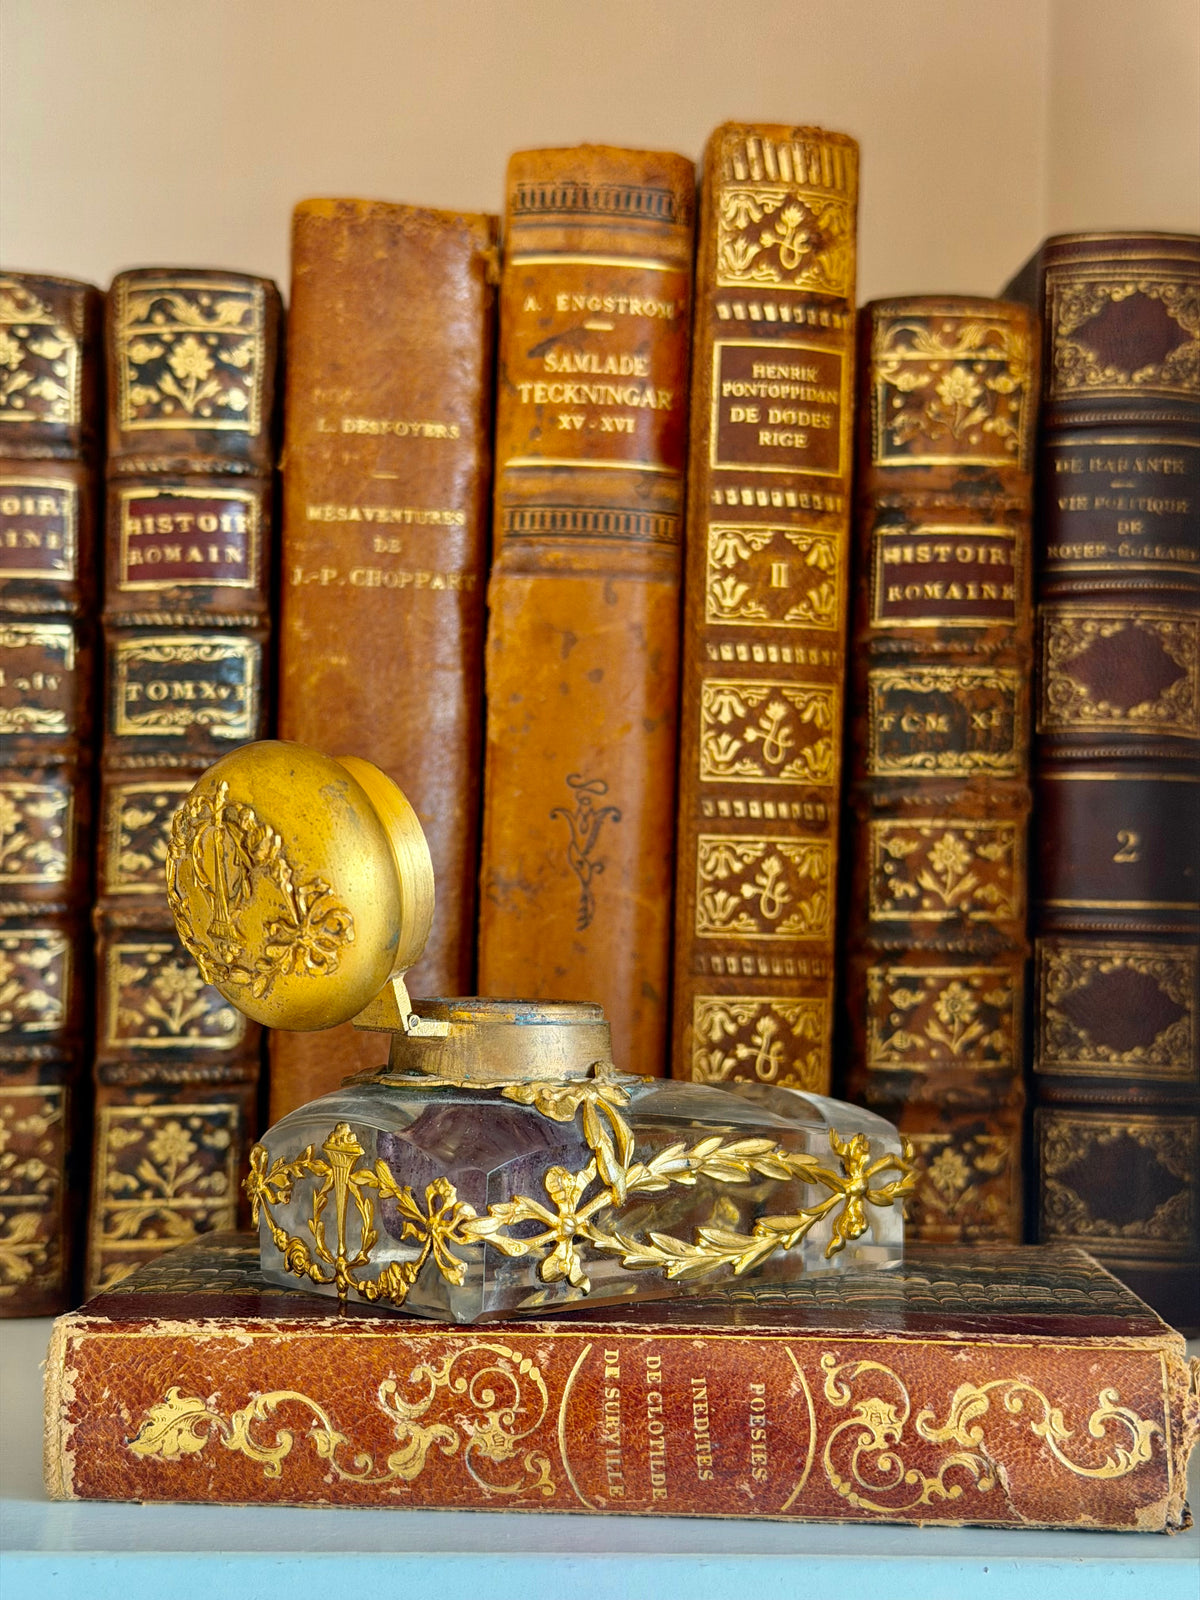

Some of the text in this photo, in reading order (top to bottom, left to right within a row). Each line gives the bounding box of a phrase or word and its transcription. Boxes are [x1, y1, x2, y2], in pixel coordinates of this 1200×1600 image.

[544, 352, 650, 377] SAMLADE
[752, 363, 818, 382] HENRIK
[518, 382, 673, 410] TECKNINGAR
[722, 381, 838, 404] PONTOPPIDAN
[730, 406, 760, 423] DE
[759, 430, 807, 448] RIGE
[1055, 456, 1083, 474] DE
[1058, 496, 1188, 515] VIE POLITIQUE
[1117, 520, 1143, 535] DE
[127, 544, 243, 565] ROMAIN
[374, 536, 402, 554] DE
[350, 568, 477, 590] CHOPPART
[770, 563, 789, 588] II
[887, 581, 1015, 602] ROMAINE
[1113, 830, 1140, 864] 2
[604, 1349, 624, 1497] DE SURVILLE
[647, 1355, 667, 1499] DE CLOTILDE
